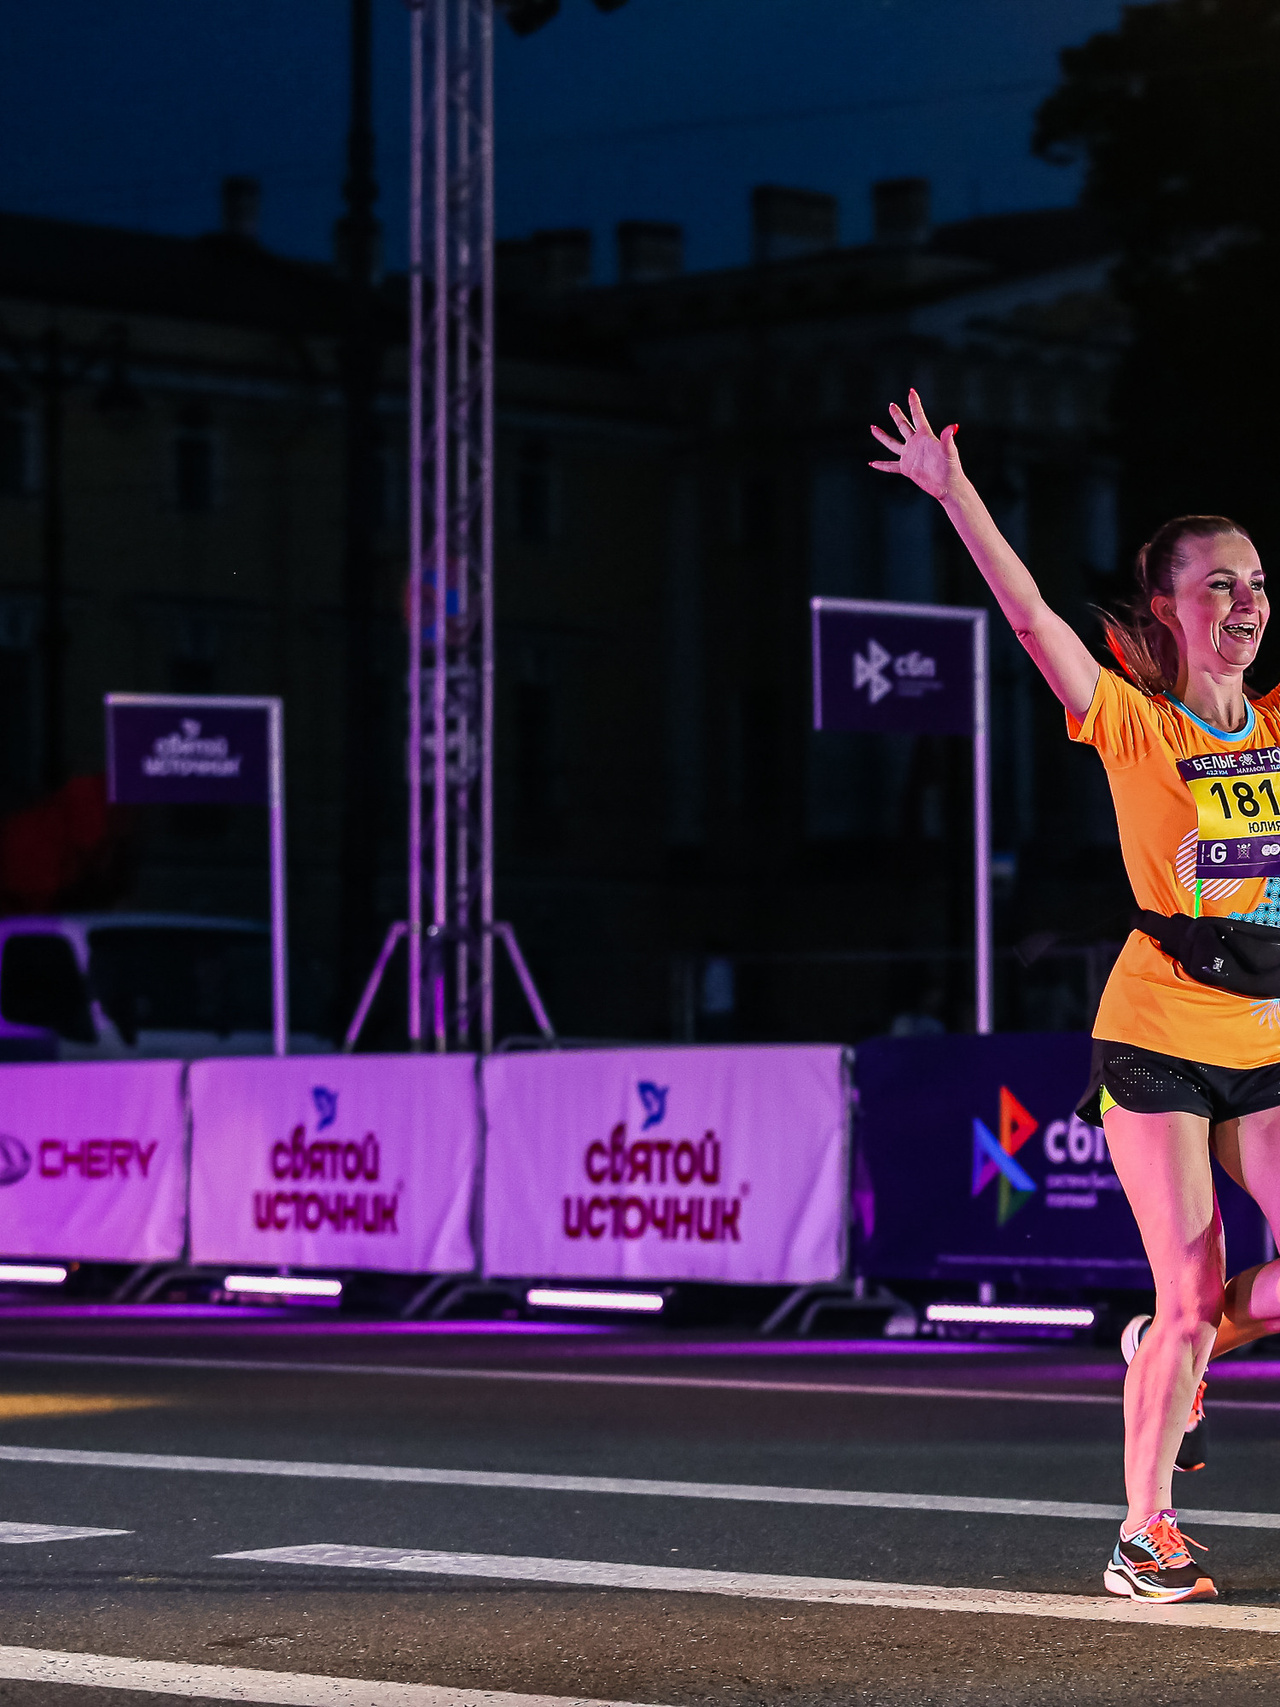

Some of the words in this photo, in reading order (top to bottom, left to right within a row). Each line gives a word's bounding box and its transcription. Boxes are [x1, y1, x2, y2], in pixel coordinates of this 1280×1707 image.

[1192, 754, 1238, 771] БЕЛЫЕ
[1210, 842, 1227, 864] G
[39, 1139, 157, 1179] CHERY
